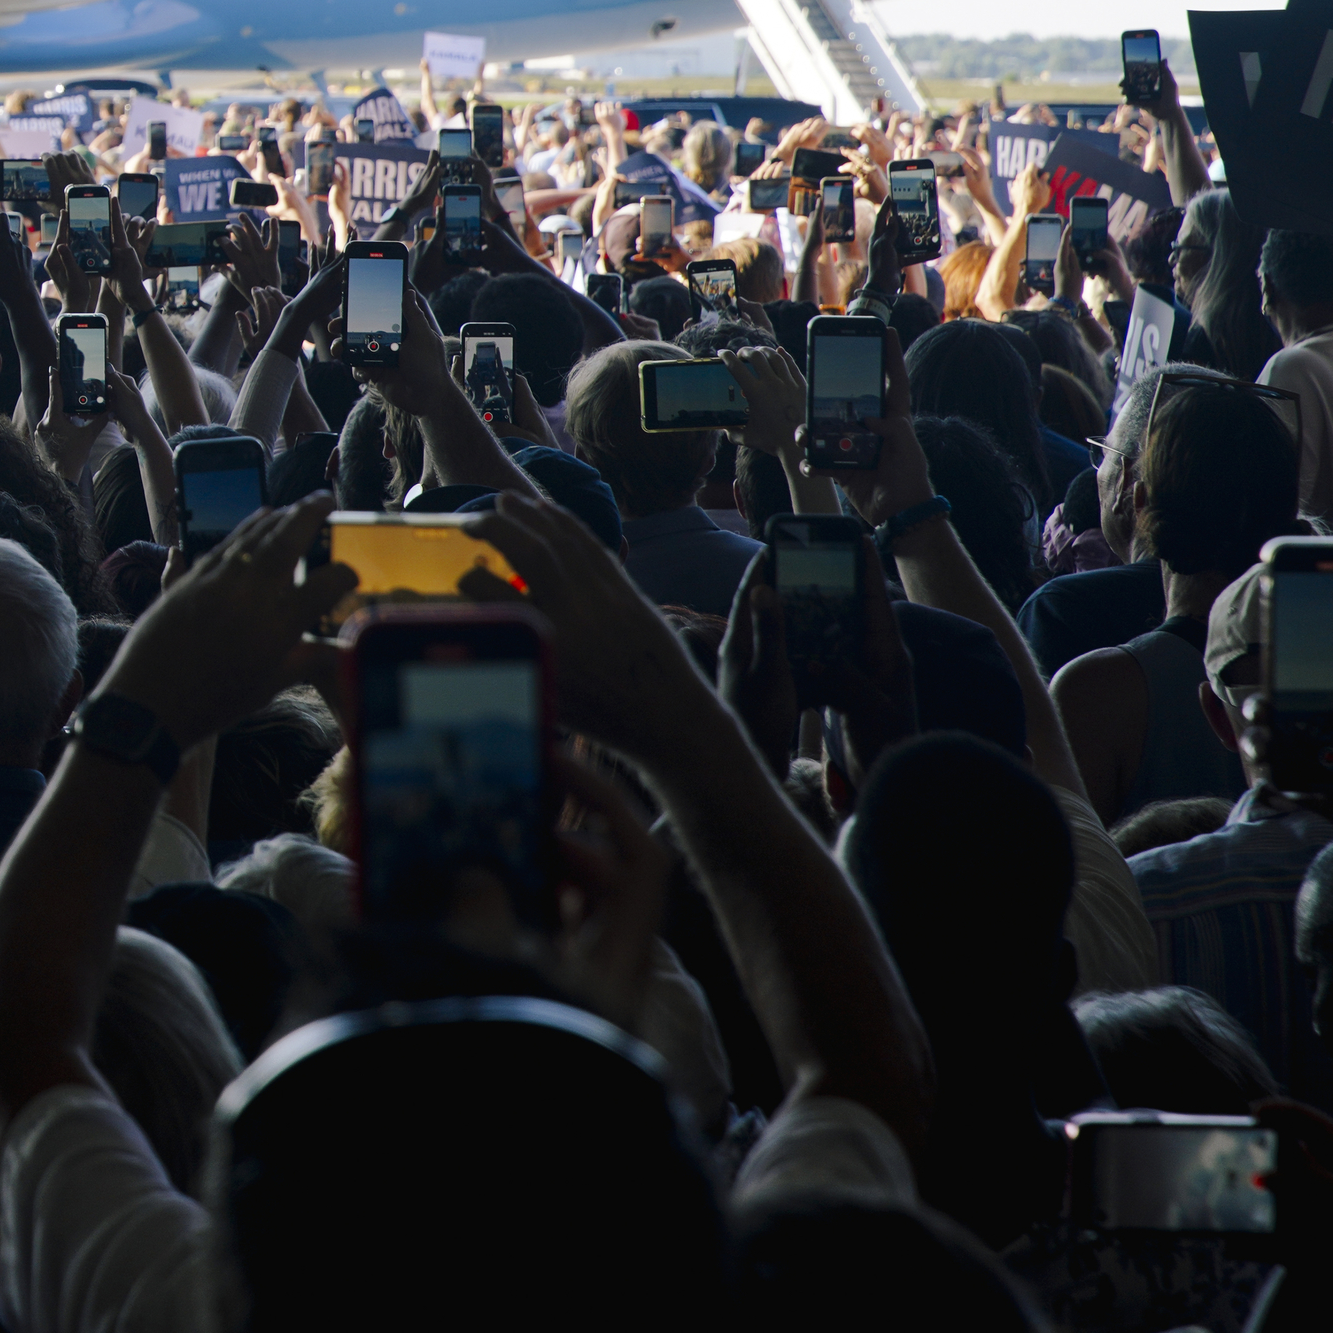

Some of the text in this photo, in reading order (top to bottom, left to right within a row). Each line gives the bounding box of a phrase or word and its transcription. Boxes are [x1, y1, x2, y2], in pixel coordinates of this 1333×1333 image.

[355, 96, 401, 123] HARR
[996, 135, 1055, 178] HAR
[179, 169, 221, 184] WHEN
[178, 181, 222, 213] WE
